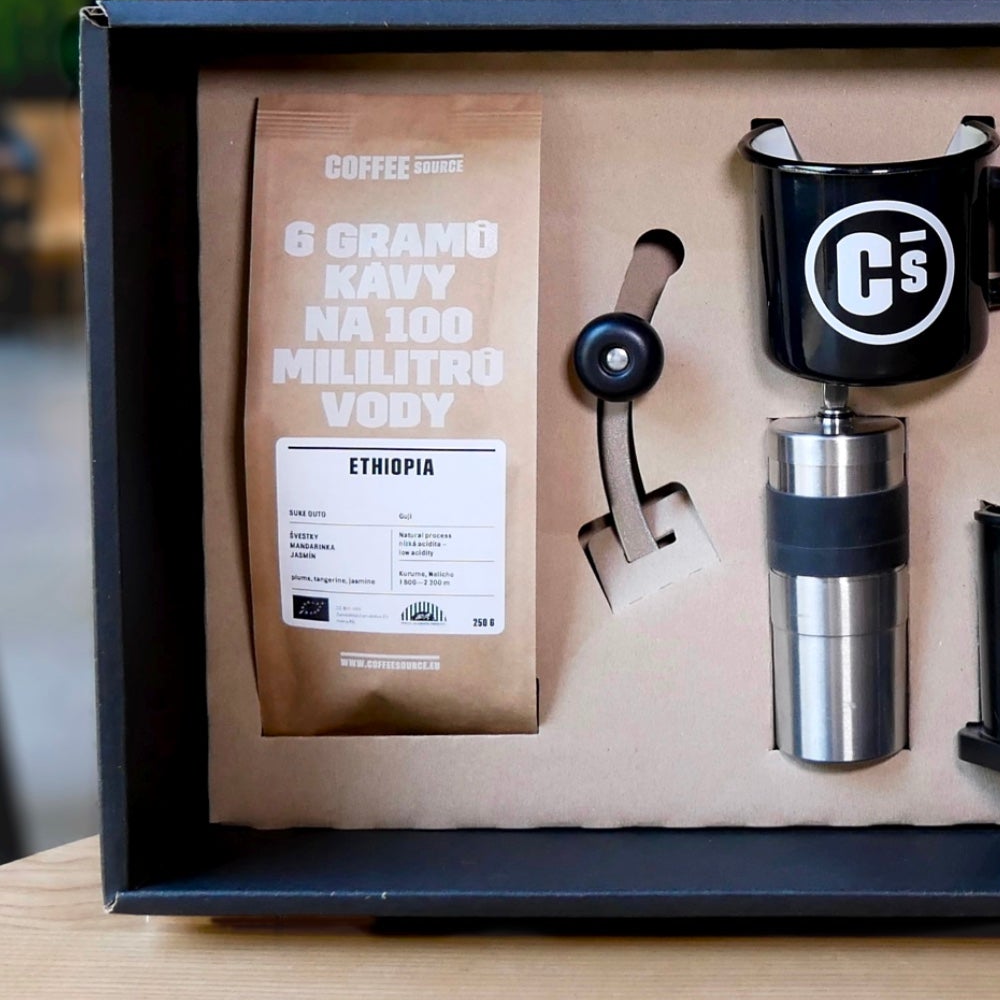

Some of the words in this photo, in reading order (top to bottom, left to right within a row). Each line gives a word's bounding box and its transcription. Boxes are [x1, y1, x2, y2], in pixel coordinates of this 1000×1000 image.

[325, 155, 410, 180] COFFEE
[414, 159, 464, 174] SOURCE
[284, 221, 315, 257] 6
[326, 220, 498, 259] GRAMŮ
[324, 262, 456, 300] KÁVY
[304, 306, 374, 342] NA
[384, 306, 473, 344] 100
[272, 347, 504, 387] MILILITRŮ
[321, 391, 455, 429] VODY
[349, 457, 435, 476] ETHIOPIA
[289, 542, 335, 550] MANDARINKA
[411, 549, 434, 557] acidity
[348, 577, 376, 585] jasmine
[473, 618, 488, 627] 250
